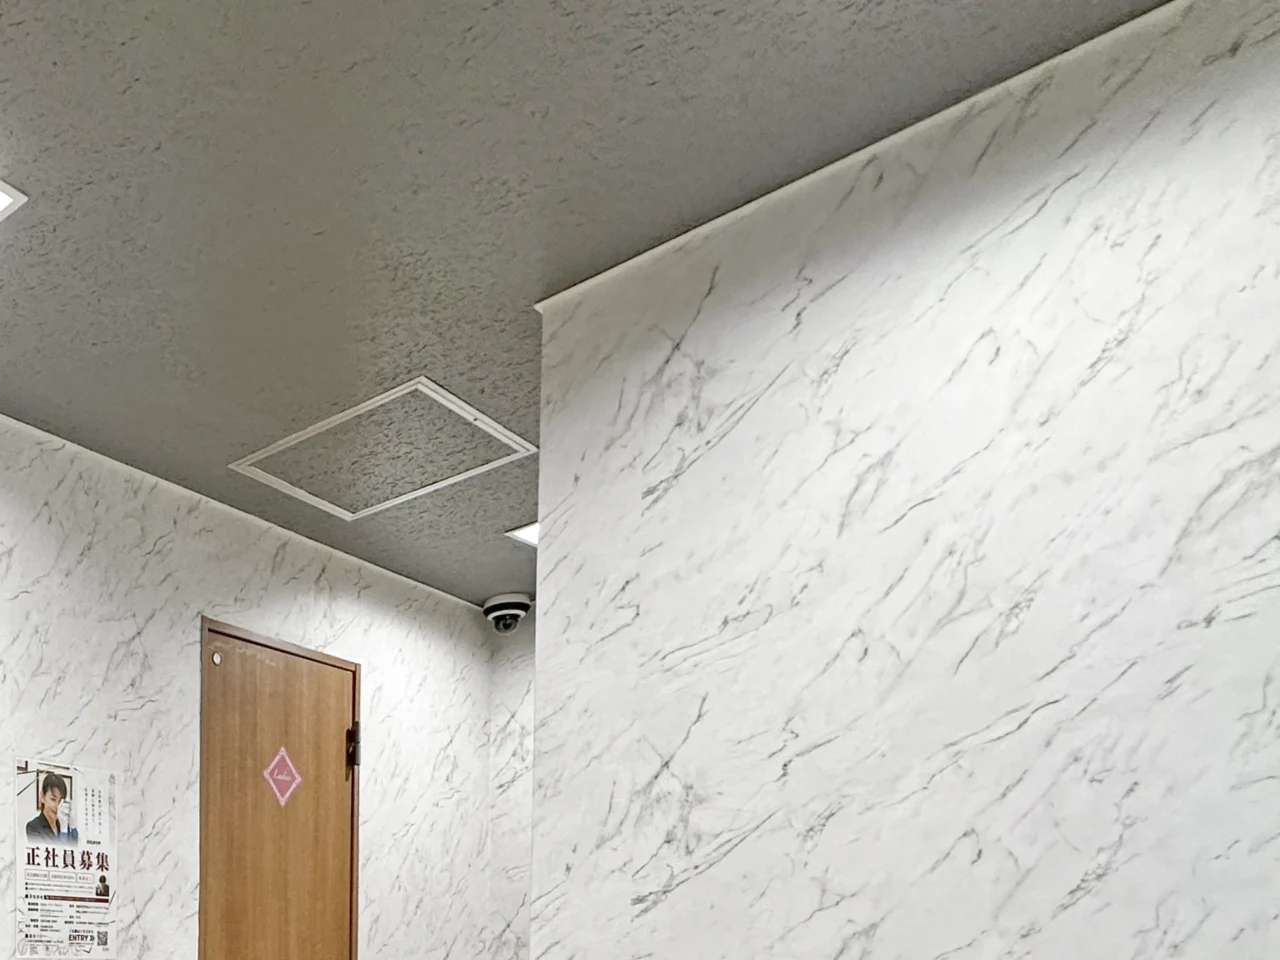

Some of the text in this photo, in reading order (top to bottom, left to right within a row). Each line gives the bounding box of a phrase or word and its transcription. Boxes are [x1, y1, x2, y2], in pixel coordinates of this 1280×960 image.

[25, 846, 110, 872] 正社員募集
[69, 934, 89, 942] ENTRY
